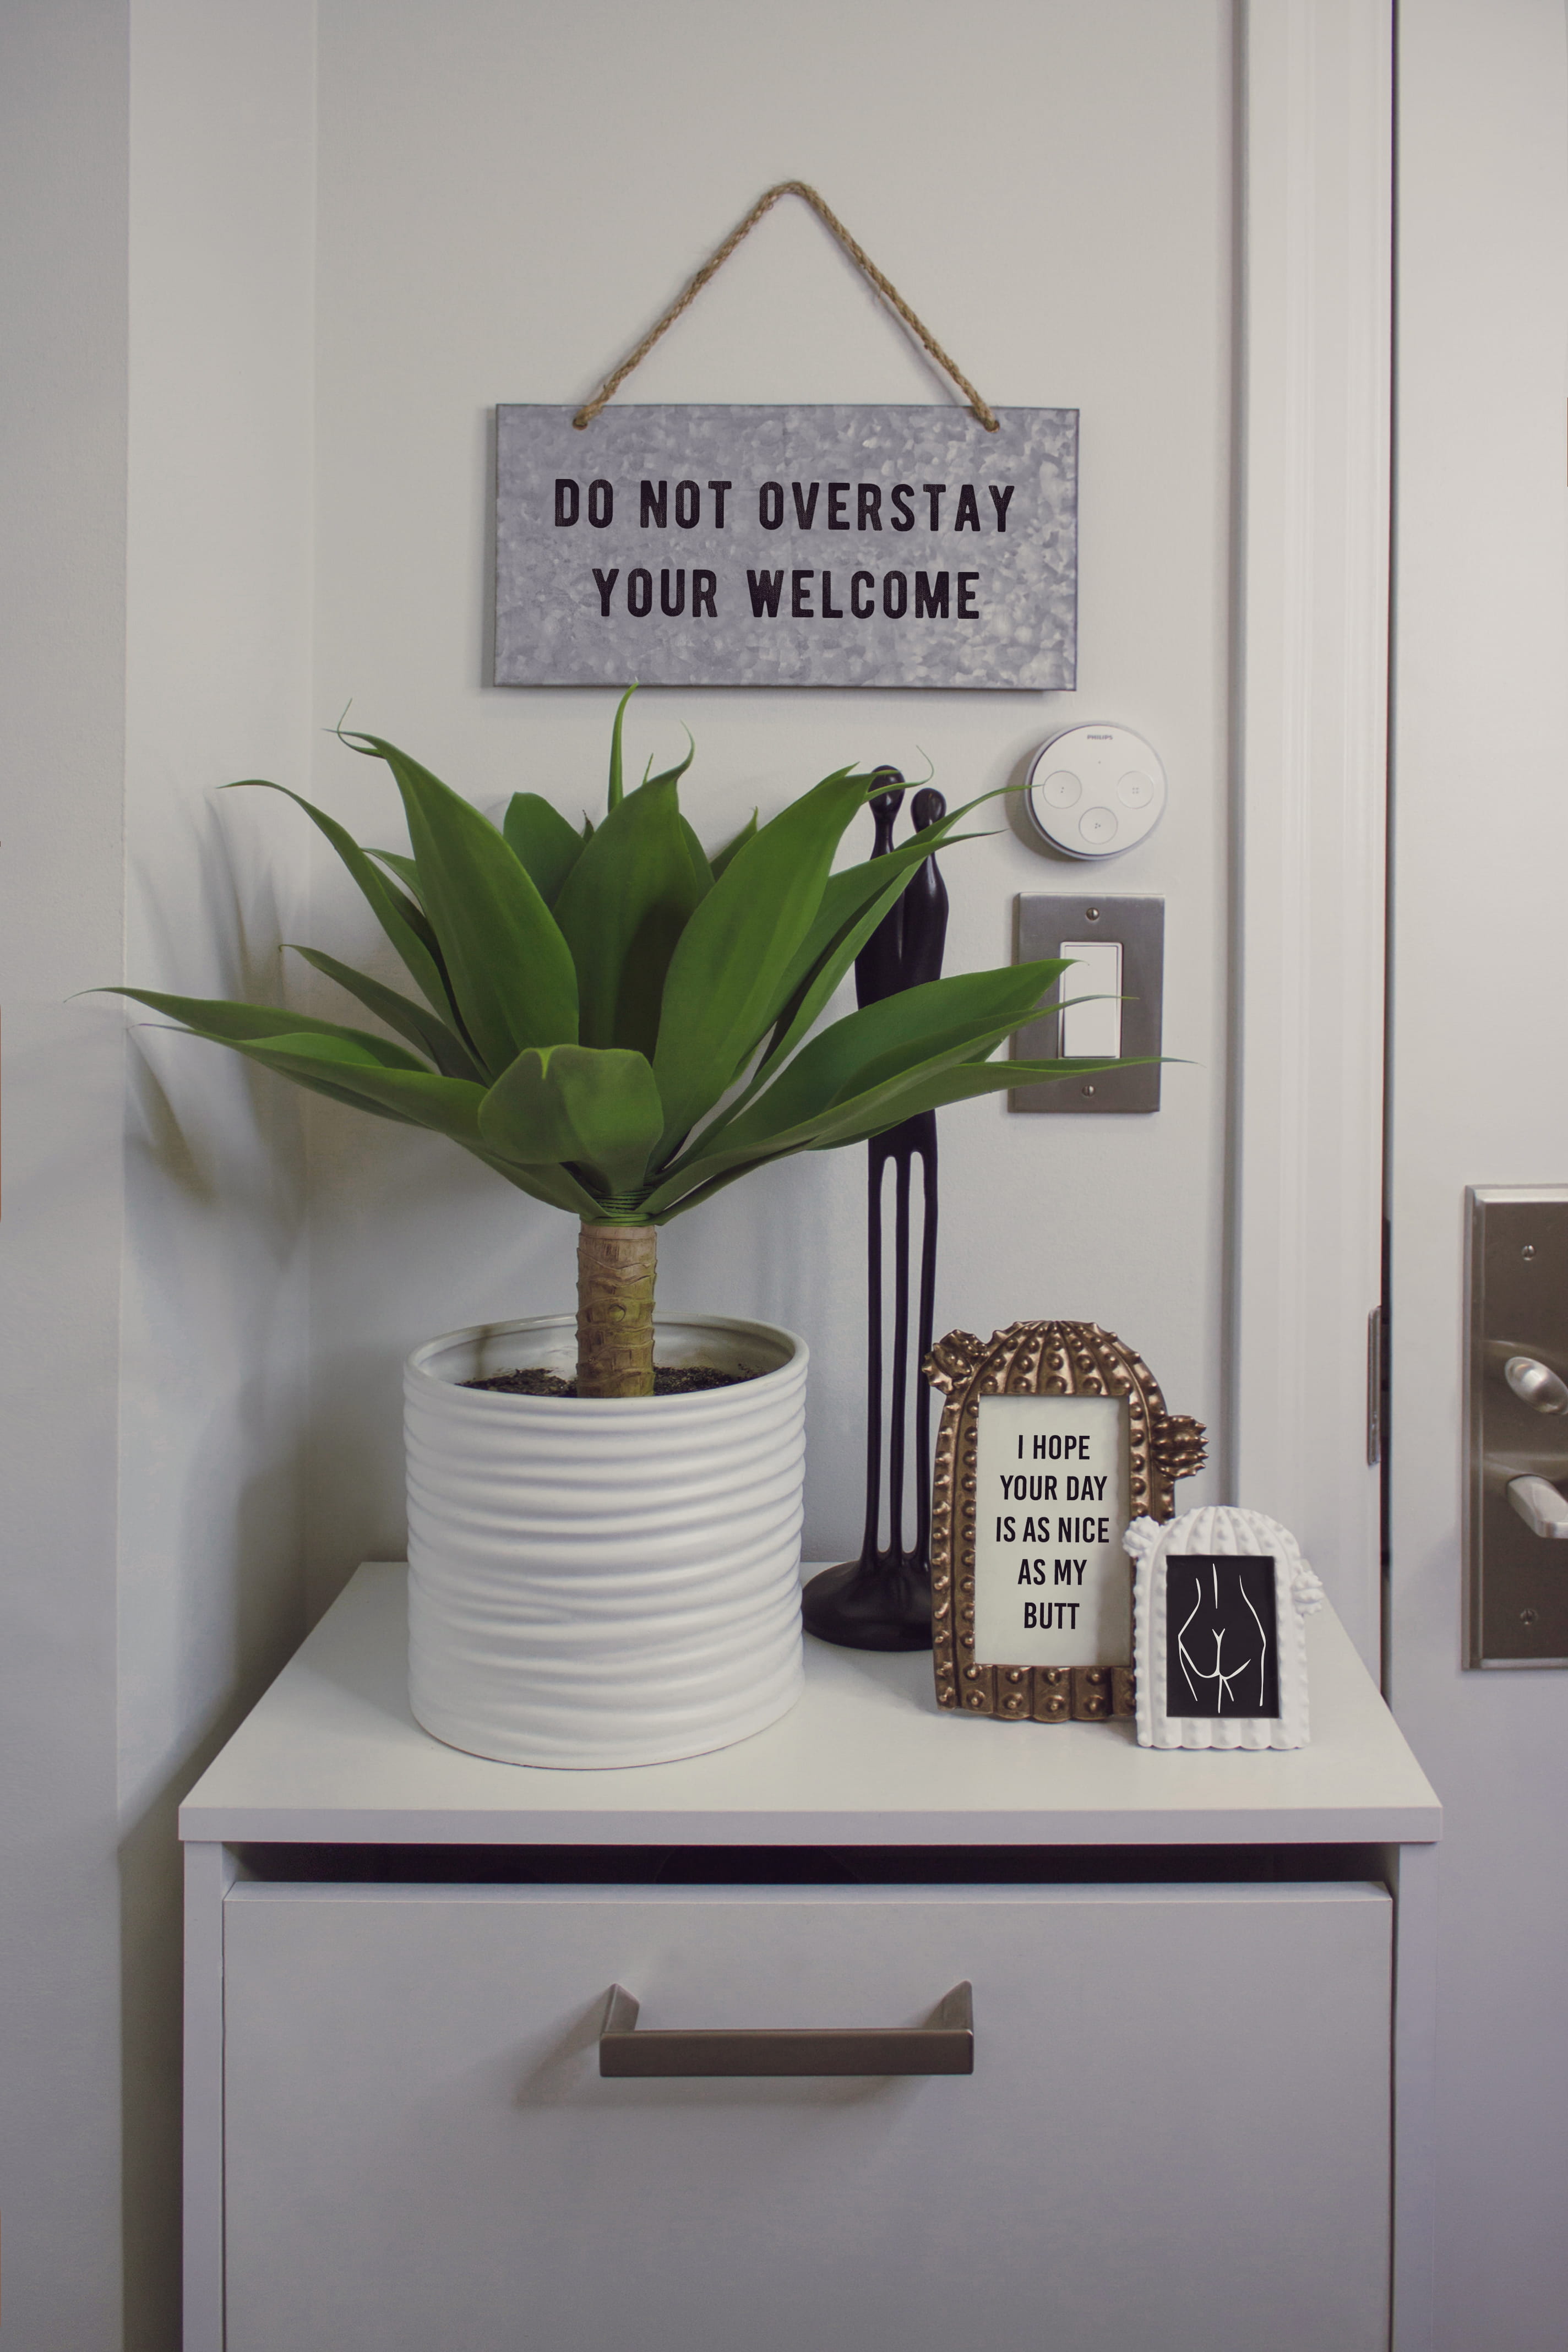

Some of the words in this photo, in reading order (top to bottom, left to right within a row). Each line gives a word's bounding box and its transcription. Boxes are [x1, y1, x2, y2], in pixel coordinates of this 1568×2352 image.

[554, 478, 613, 529] DO
[640, 480, 732, 529] NOT
[759, 481, 1015, 532] OVERSTAY
[592, 568, 718, 618] YOUR
[746, 569, 979, 619] WELCOME
[1018, 1435, 1023, 1459] I
[1033, 1435, 1090, 1460] HOPE
[1000, 1475, 1058, 1501] YOUR
[1066, 1476, 1108, 1501] DAY
[996, 1516, 1016, 1542] IS
[1022, 1517, 1050, 1543] AS
[1058, 1517, 1109, 1543] NICE
[1017, 1559, 1046, 1585] AS
[1054, 1559, 1087, 1586] MY
[1024, 1602, 1080, 1630] BUTT
